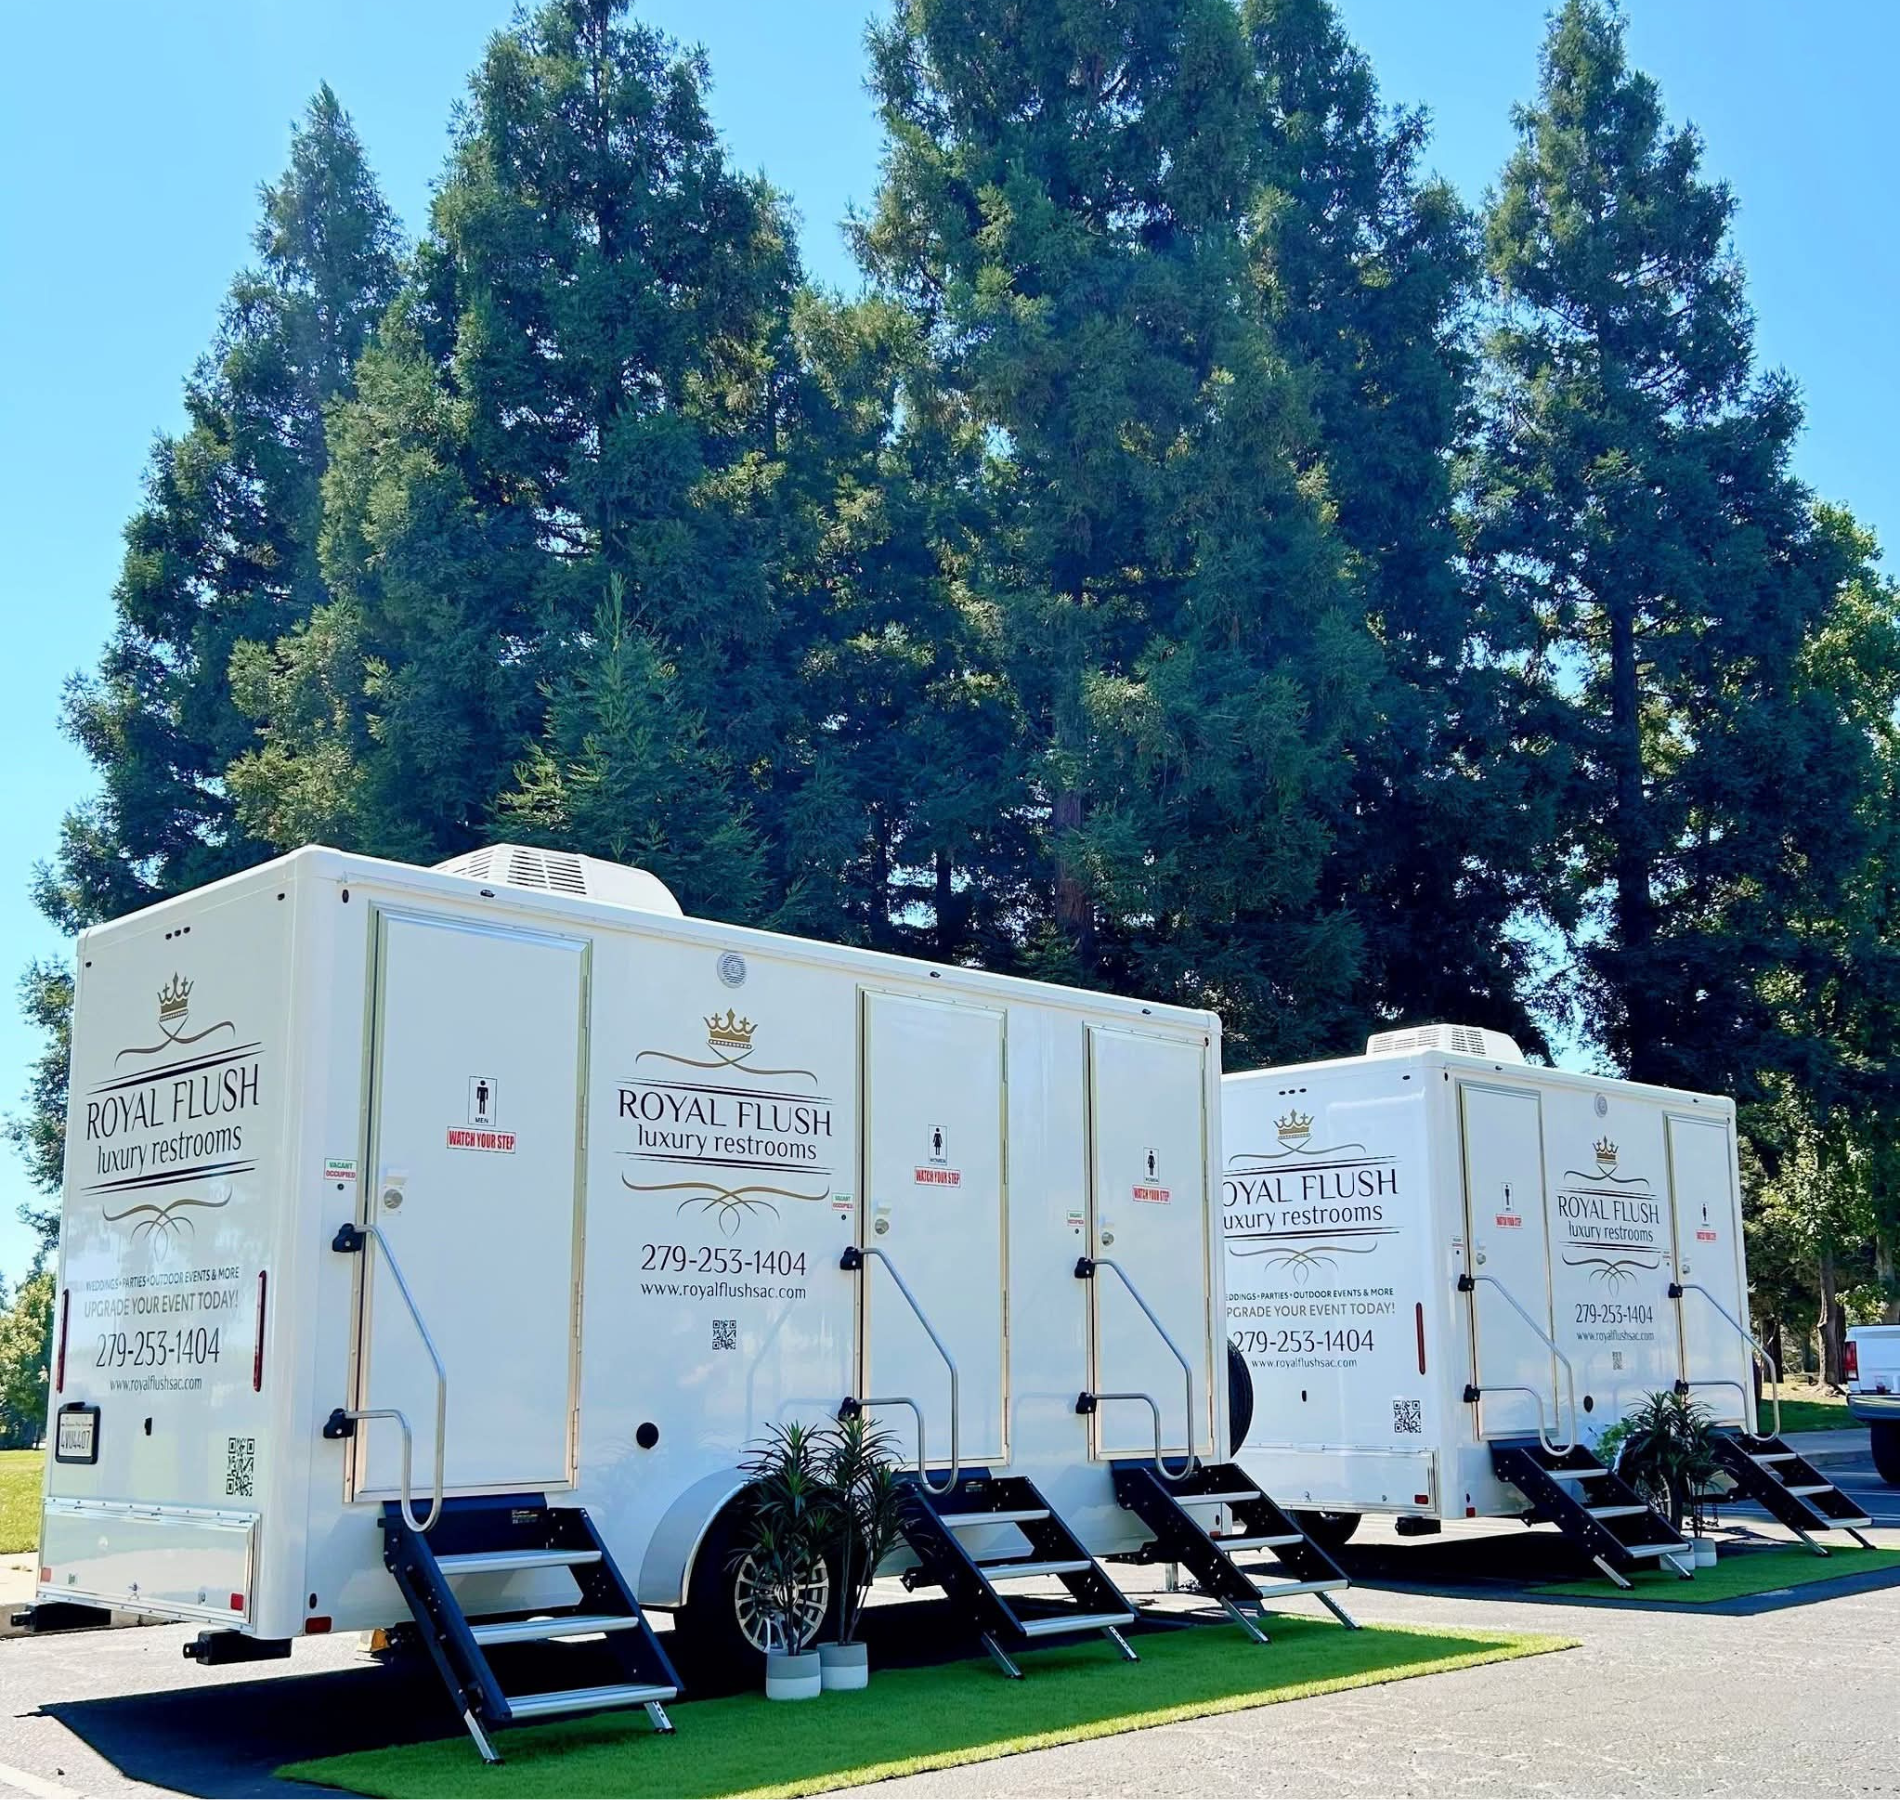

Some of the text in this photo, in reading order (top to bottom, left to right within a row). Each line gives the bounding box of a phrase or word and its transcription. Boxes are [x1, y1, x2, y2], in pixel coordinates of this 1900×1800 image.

[87, 1064, 259, 1140] ROYAL FLUSH
[617, 1088, 832, 1137] ROYAL FLUSH
[98, 1126, 241, 1175] luxury restrooms
[449, 1130, 514, 1150] WATCH YOUR STEP
[639, 1124, 816, 1160] luxury restrooms
[326, 1170, 356, 1178] OCCUPIED
[916, 1170, 960, 1184] WATCH YOUR STEP
[1223, 1169, 1399, 1206] OYAL FLUSH
[1224, 1205, 1382, 1232] uxury restrooms
[1557, 1195, 1660, 1224] ROYAL FLUSH
[1568, 1220, 1654, 1242] luxury restrooms
[641, 1243, 806, 1276] 279-253-1404
[185, 1269, 210, 1283] EVENTS
[211, 1269, 217, 1279] &
[218, 1267, 240, 1280] MORE
[640, 1280, 806, 1300] www.royalflushsac.com
[1226, 1292, 1256, 1301] EDDINGS
[1333, 1289, 1362, 1298] EVENTS
[1370, 1288, 1394, 1296] MORE
[84, 1290, 238, 1318] UPGRADE YOUR EVENT TODAY!
[1227, 1302, 1395, 1318] PGRADE YOUR EVENT TODAY!
[1575, 1304, 1653, 1324] 279-253-1404
[96, 1327, 220, 1368] 279-253-1404
[1232, 1328, 1374, 1353] 279-253-1404
[1576, 1330, 1654, 1344] www.royalflushsac.com
[1252, 1357, 1357, 1369] www.royalflushsac.com
[110, 1375, 202, 1394] www.royalflushsac.com
